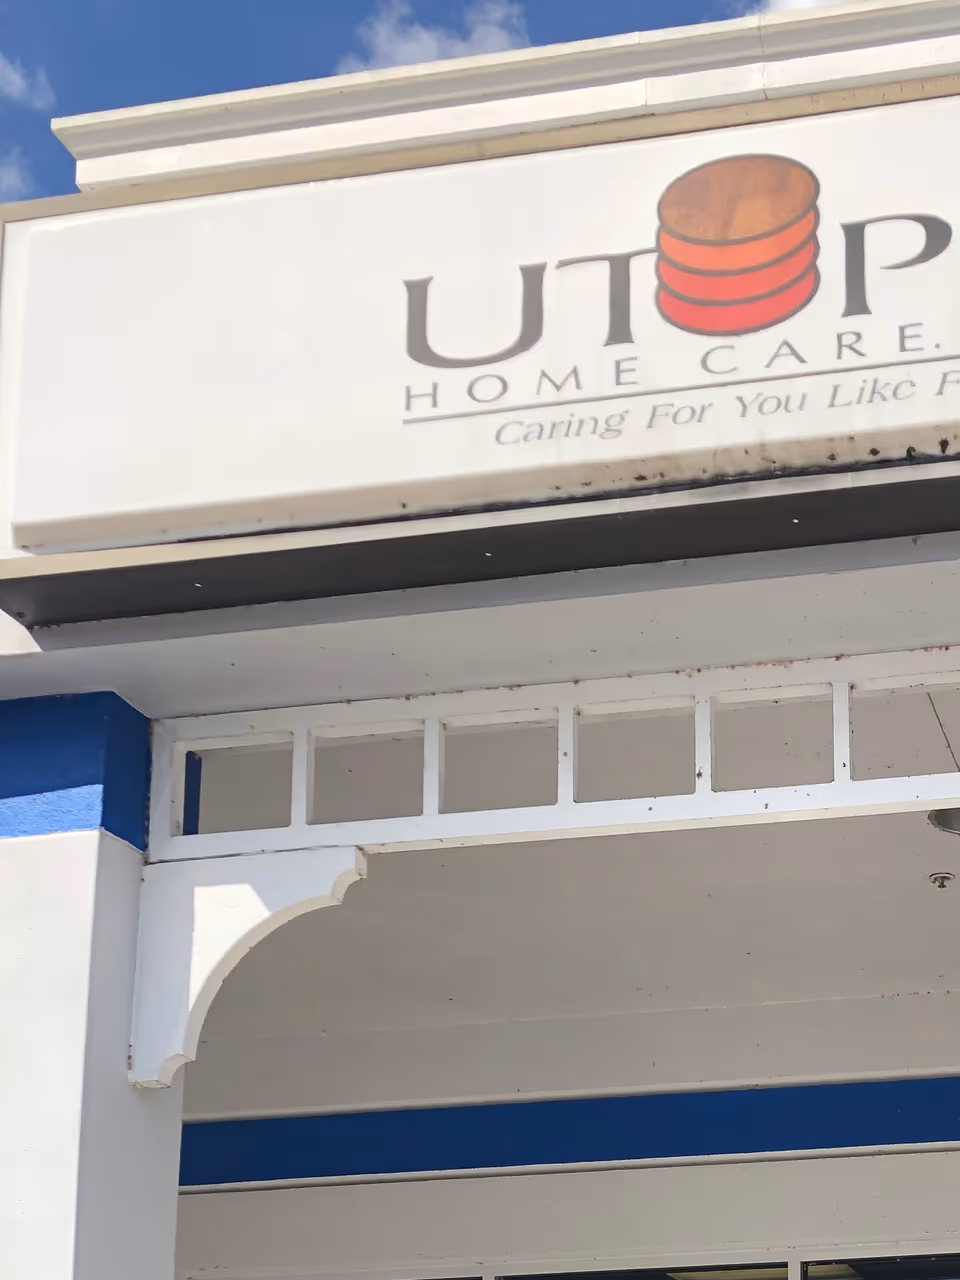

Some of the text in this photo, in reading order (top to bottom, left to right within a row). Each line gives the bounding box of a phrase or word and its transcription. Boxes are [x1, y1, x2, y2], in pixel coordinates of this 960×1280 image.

[404, 356, 640, 413] HOME
[494, 406, 630, 448] Caring
[646, 400, 713, 429] For
[735, 388, 807, 418] You
